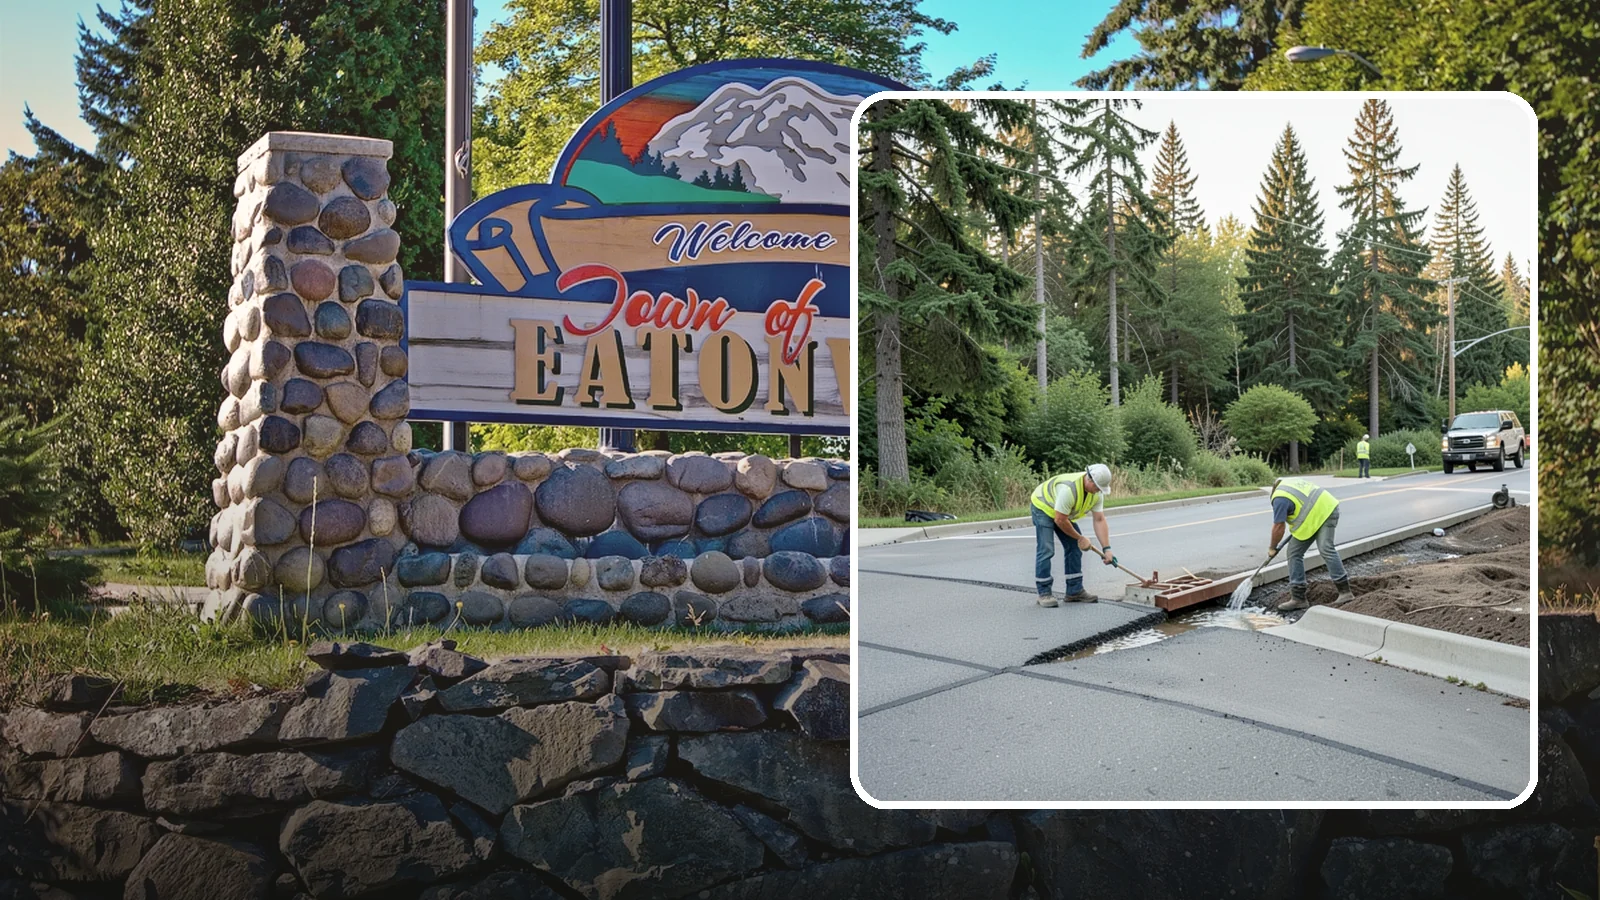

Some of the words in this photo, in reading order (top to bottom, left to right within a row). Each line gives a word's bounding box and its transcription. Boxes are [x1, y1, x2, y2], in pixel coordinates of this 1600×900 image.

[652, 220, 837, 263] Welcome
[556, 264, 736, 336] Town
[764, 278, 826, 366] of
